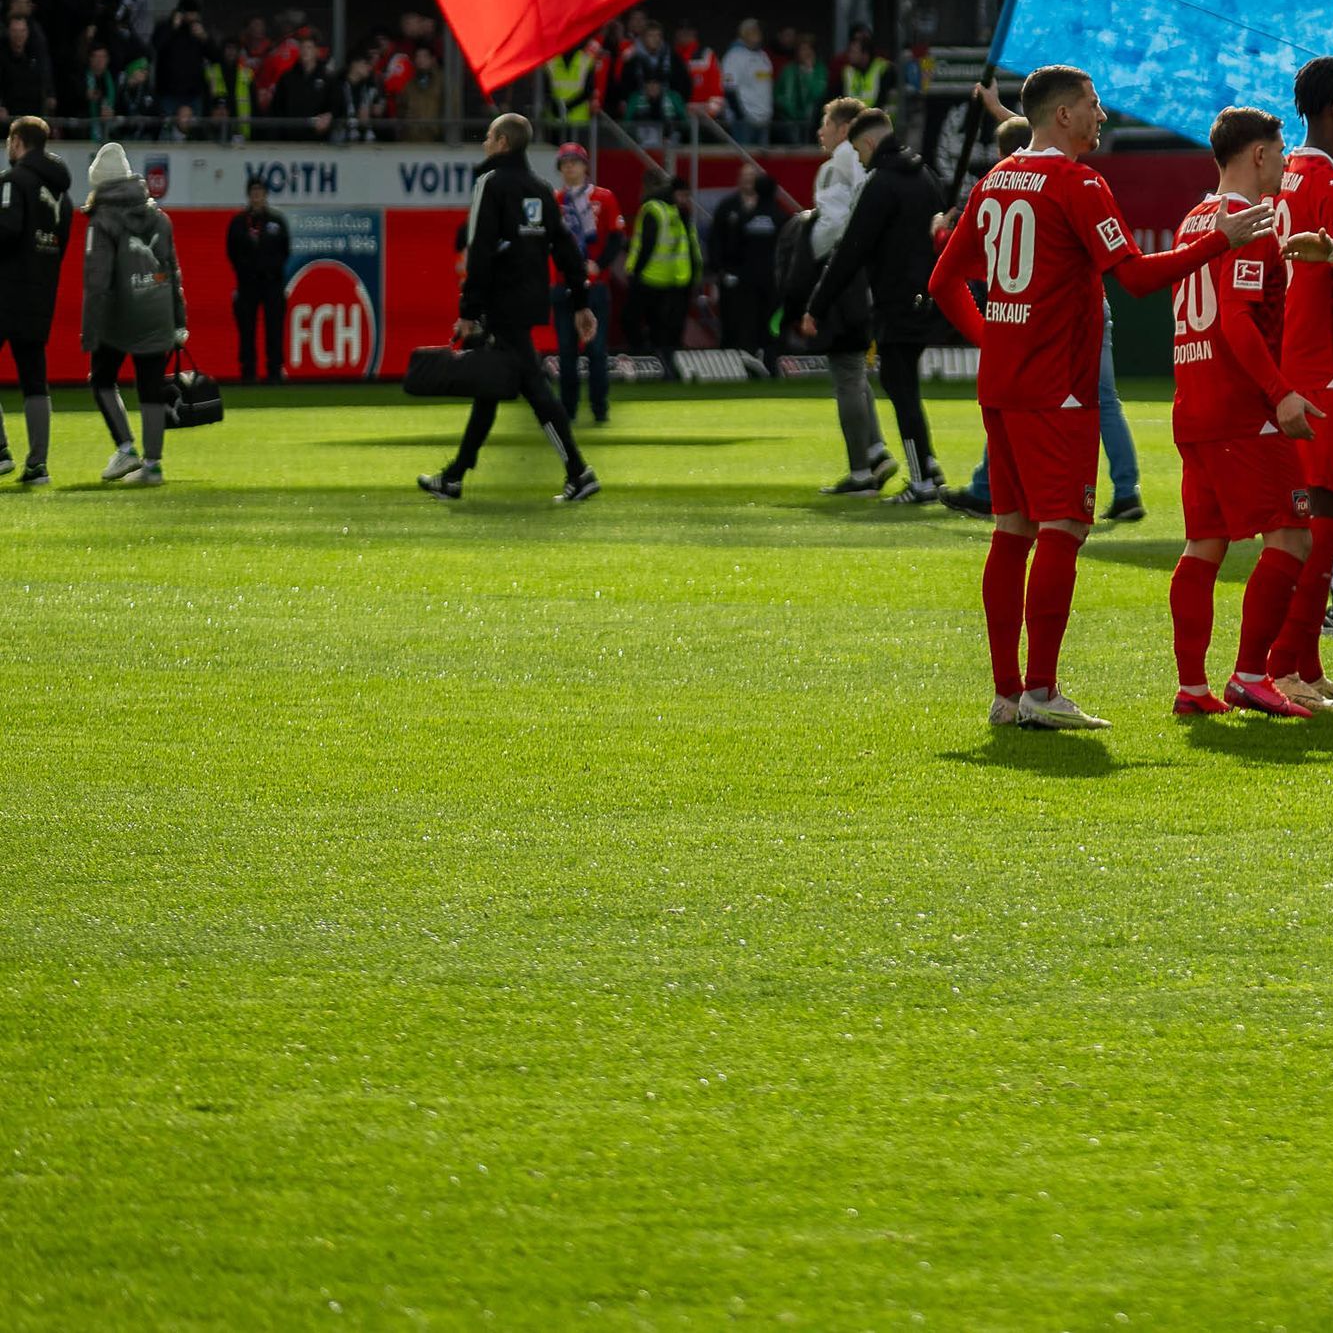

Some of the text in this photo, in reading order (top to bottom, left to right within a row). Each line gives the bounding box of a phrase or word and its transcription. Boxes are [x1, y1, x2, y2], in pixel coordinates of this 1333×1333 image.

[246, 161, 338, 194] VOITH
[977, 197, 1036, 294] 30
[290, 303, 362, 368] FCH
